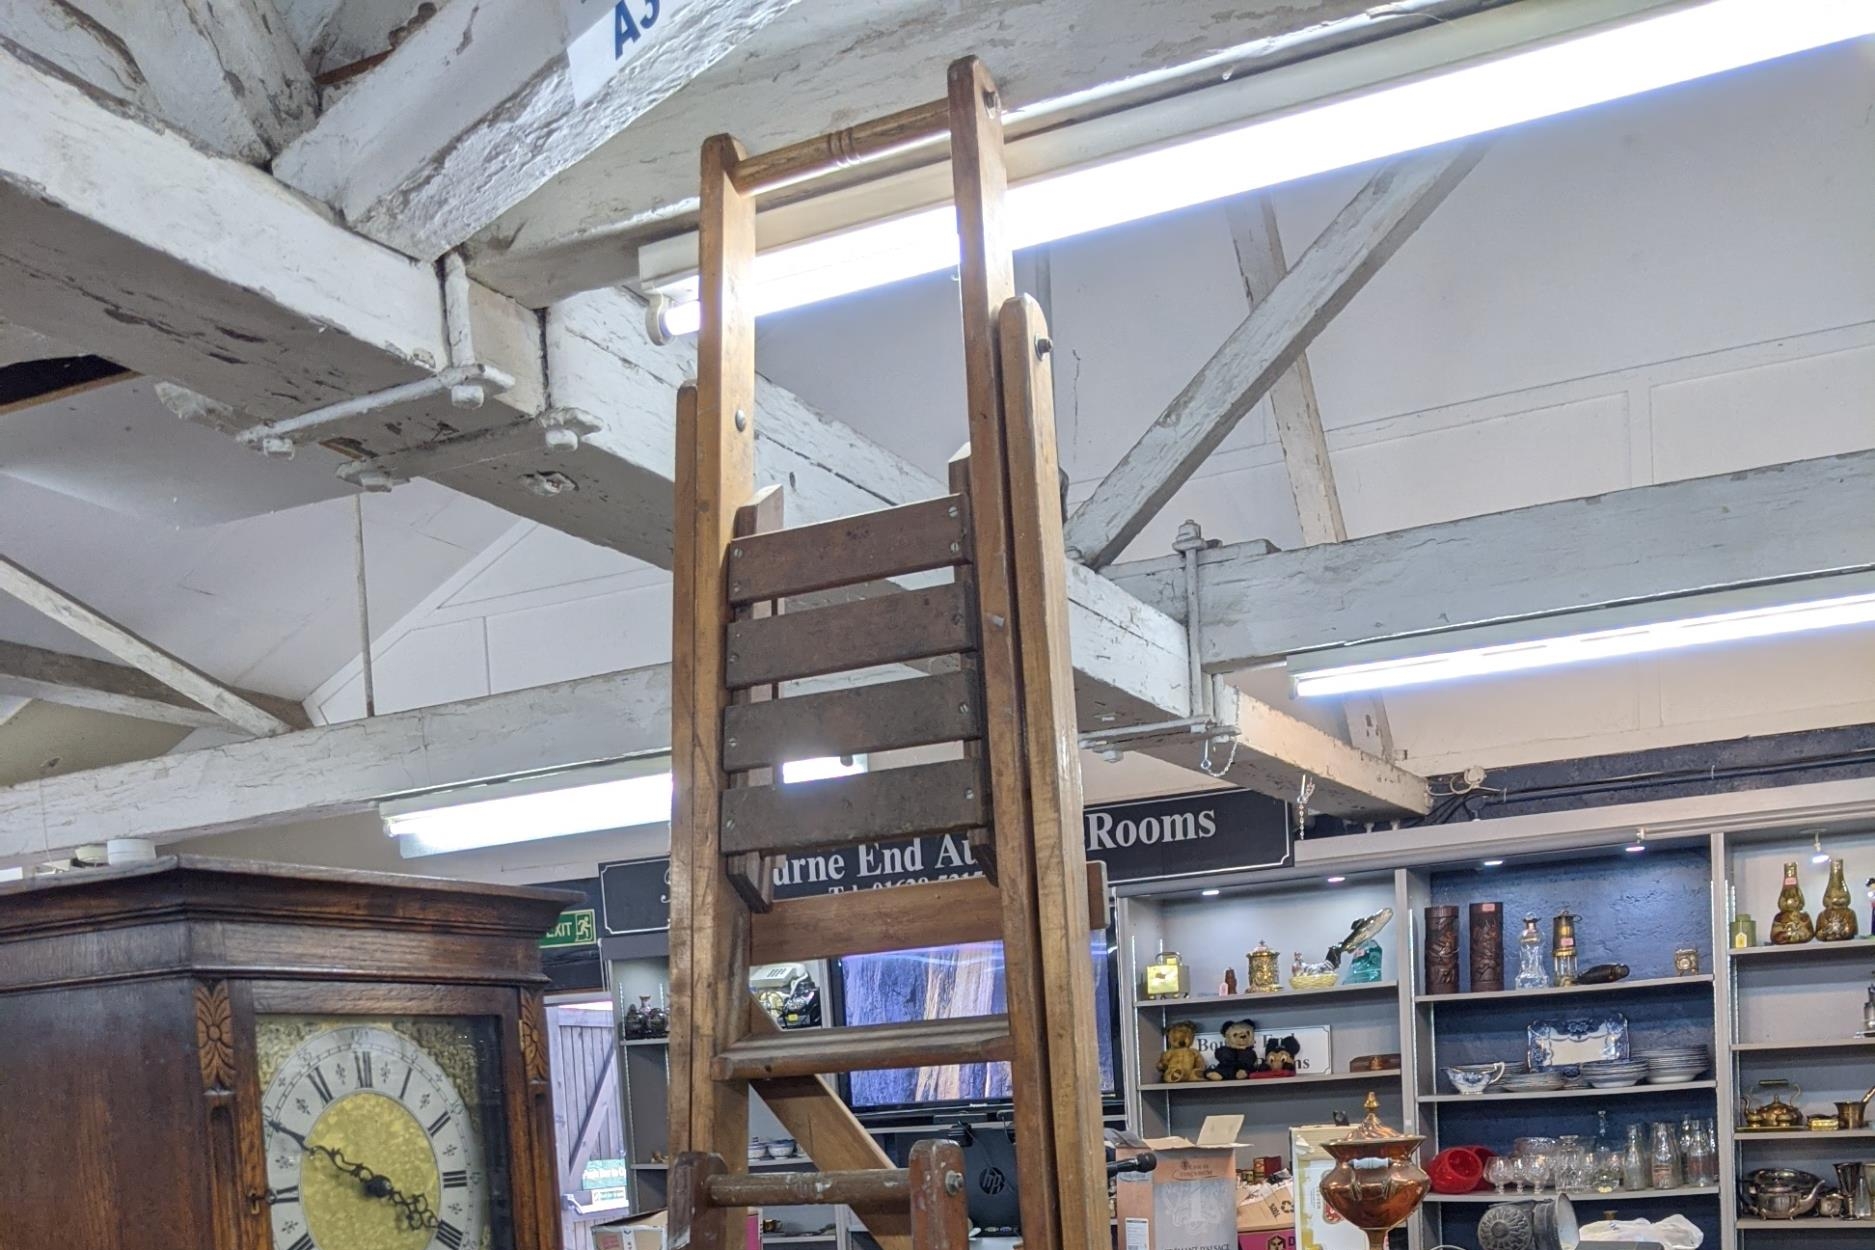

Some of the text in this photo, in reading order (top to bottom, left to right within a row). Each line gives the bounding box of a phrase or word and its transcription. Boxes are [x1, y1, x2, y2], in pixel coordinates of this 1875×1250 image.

[857, 837, 924, 877] End
[1086, 809, 1217, 851] Rooms
[980, 1167, 1004, 1194] hp
